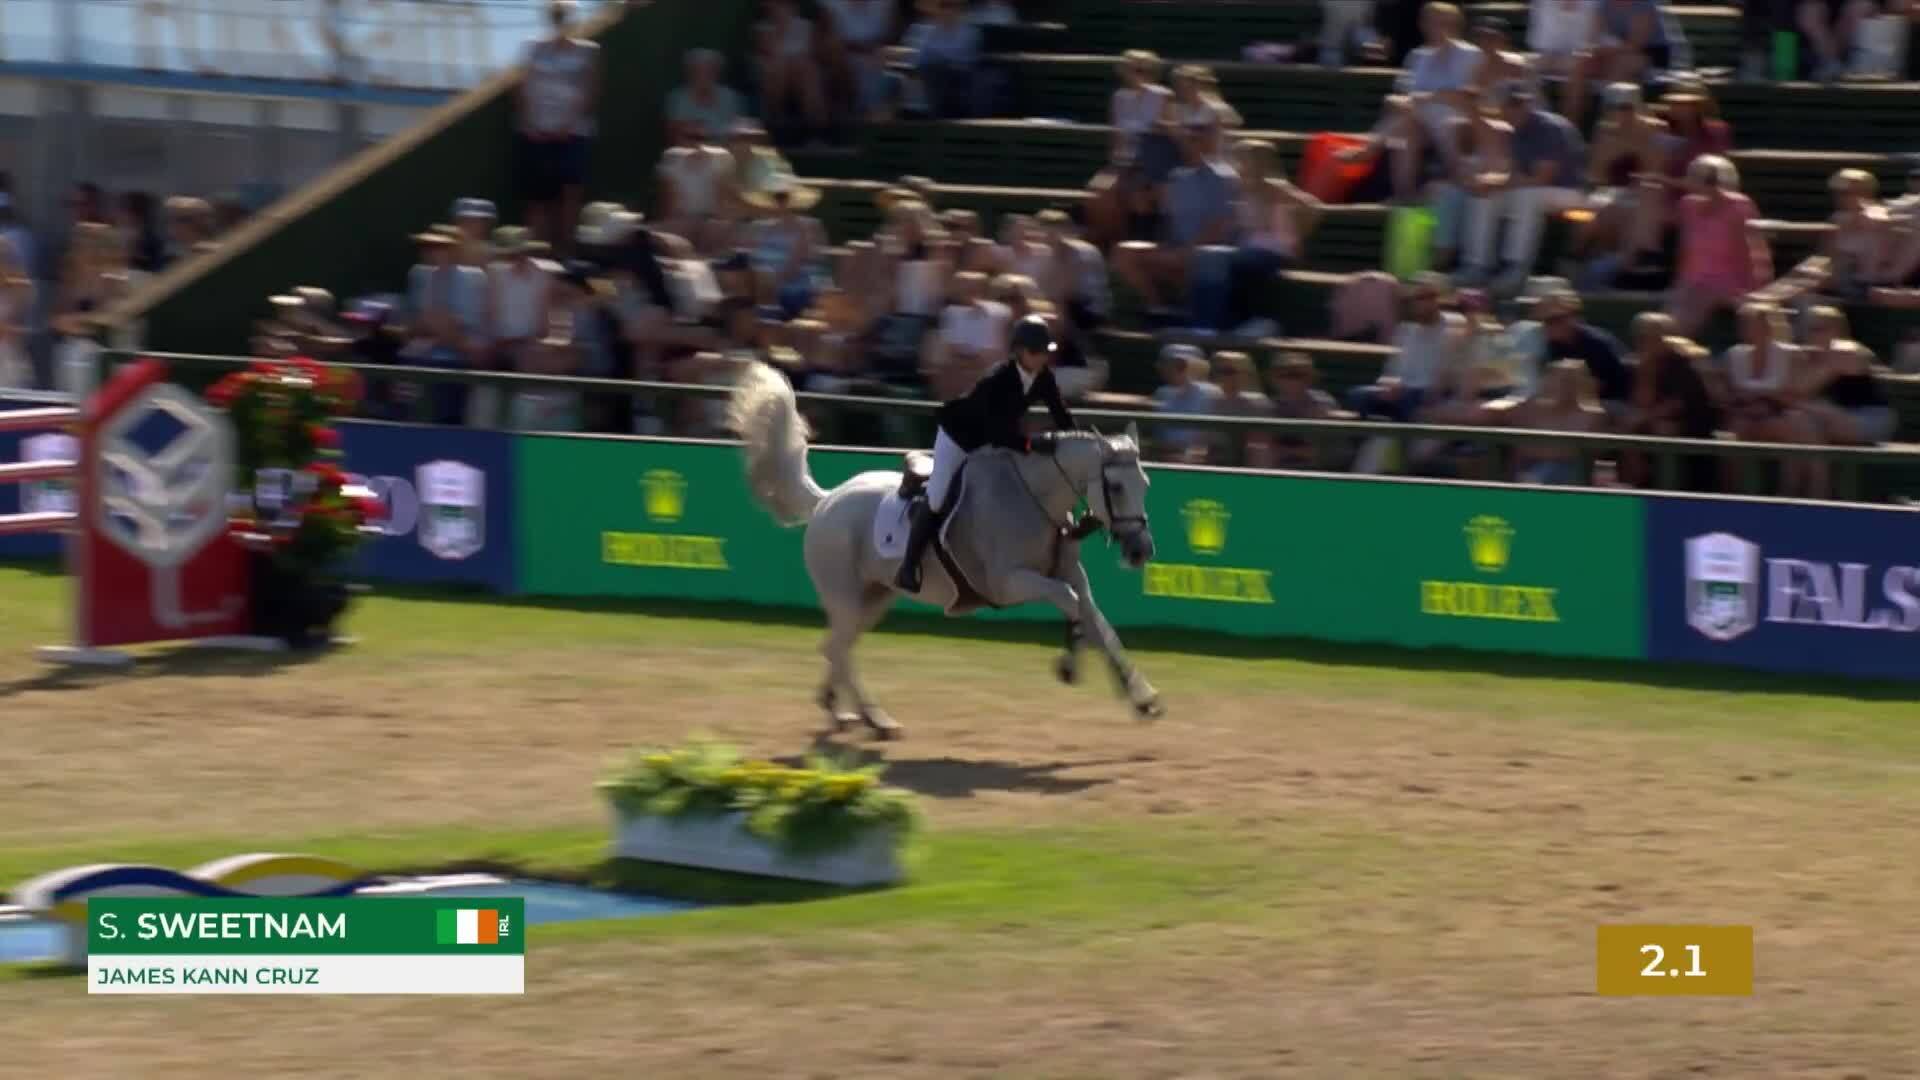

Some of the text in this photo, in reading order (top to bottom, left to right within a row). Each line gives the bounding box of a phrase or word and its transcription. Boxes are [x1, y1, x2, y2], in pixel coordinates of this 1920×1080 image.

[601, 530, 728, 571] ROLEX
[1142, 562, 1274, 605] ROLEX
[1420, 579, 1558, 623] ROLEX
